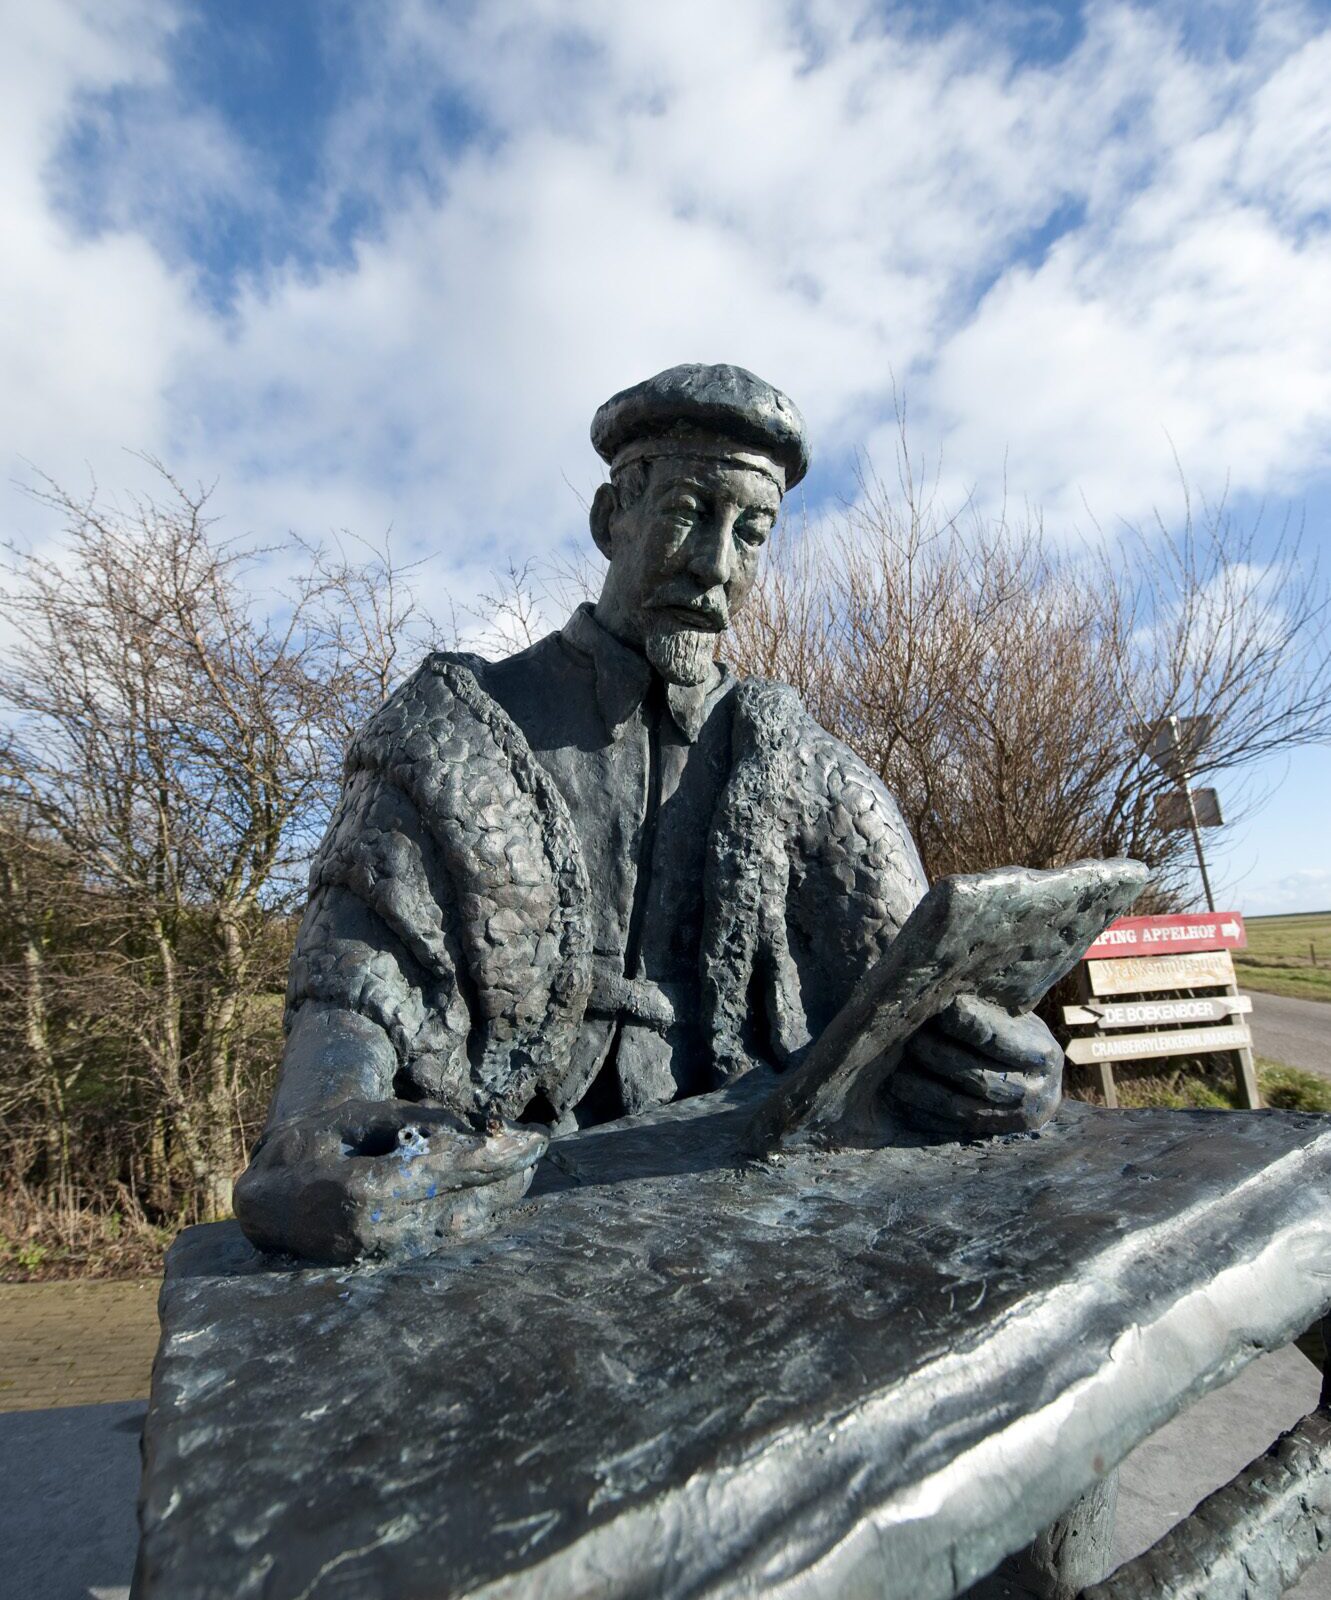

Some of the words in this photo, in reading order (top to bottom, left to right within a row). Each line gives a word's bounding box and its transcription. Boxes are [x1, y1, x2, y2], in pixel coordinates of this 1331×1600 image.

[1142, 924, 1217, 943] APPELHOF
[1105, 1007, 1125, 1023] DE
[1127, 1002, 1215, 1022] BOEKENBOER
